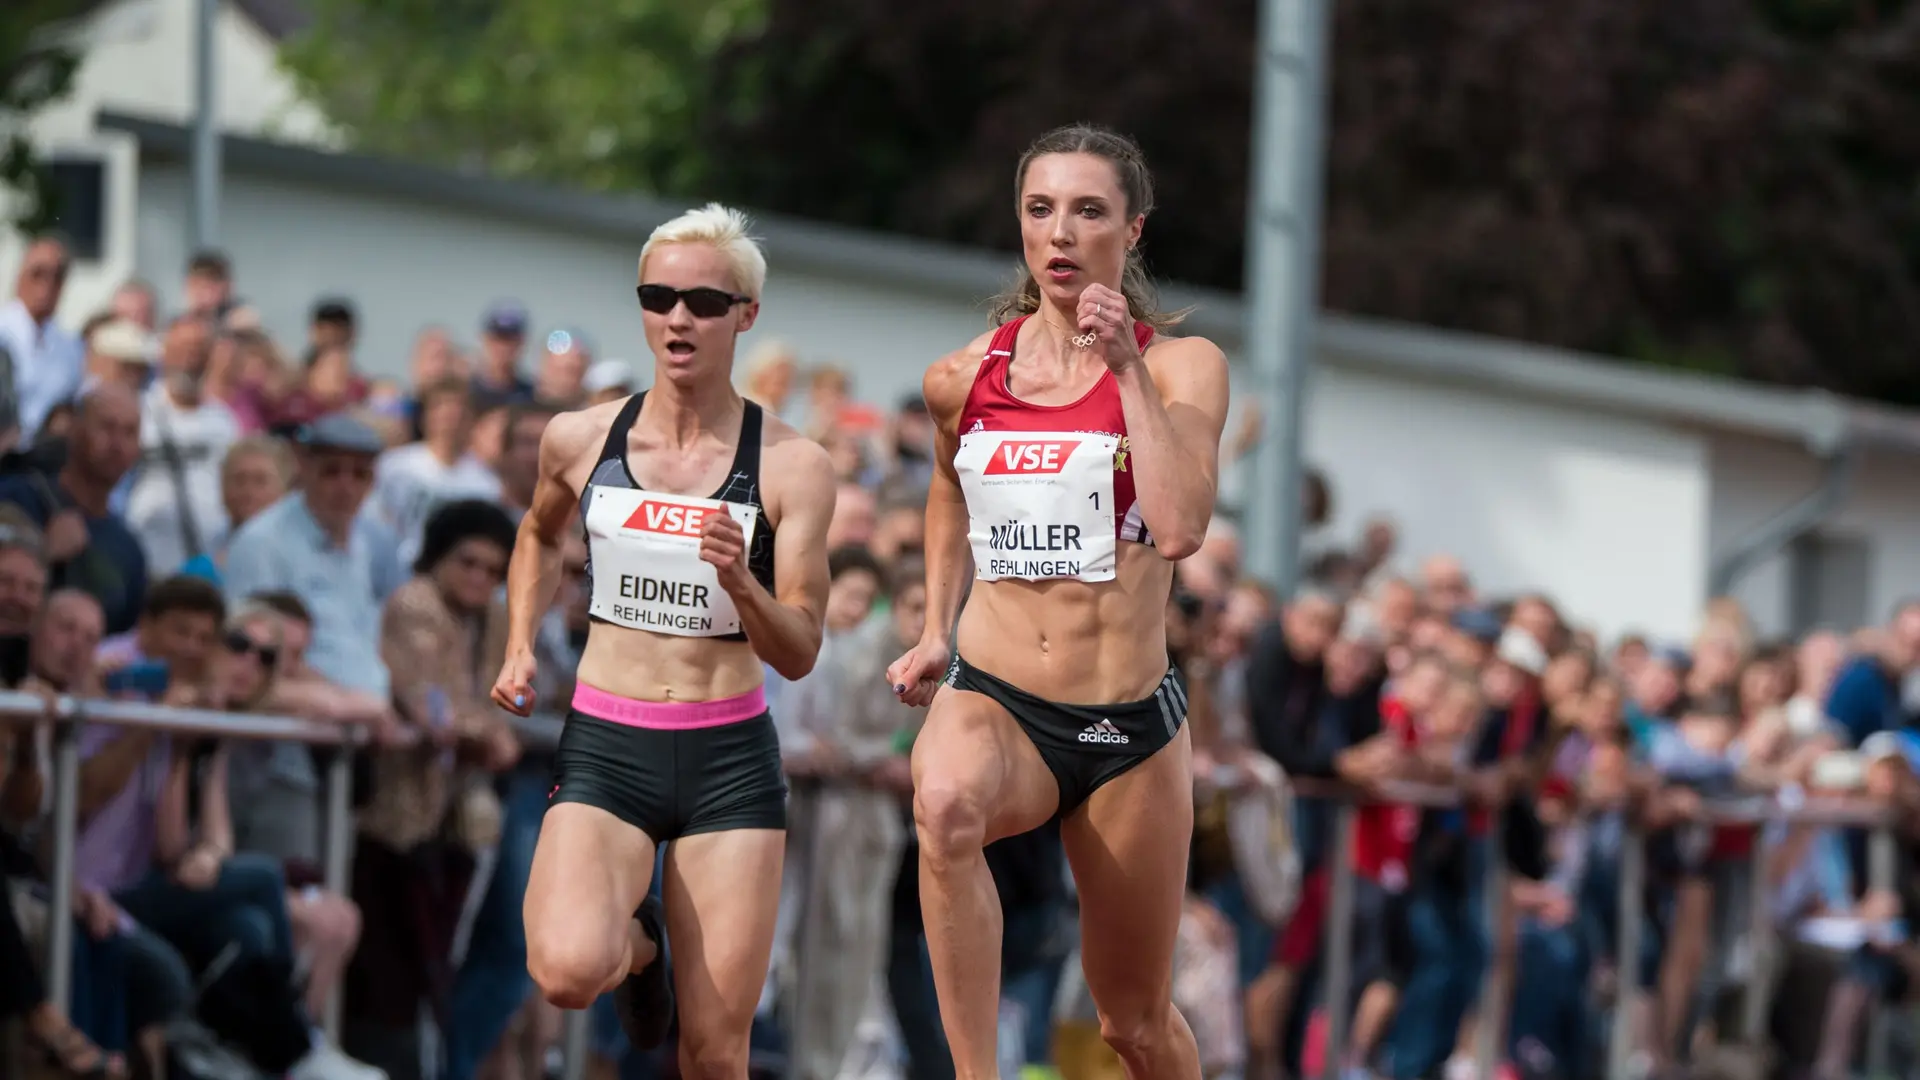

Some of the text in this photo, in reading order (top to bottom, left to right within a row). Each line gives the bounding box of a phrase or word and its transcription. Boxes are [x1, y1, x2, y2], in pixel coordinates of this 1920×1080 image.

[1003, 444, 1060, 470] VSE
[1088, 492, 1099, 510] 1
[645, 504, 703, 534] VSE
[989, 520, 1081, 550] MÜLLER
[990, 559, 1080, 576] REHLINGEN
[620, 574, 709, 608] EIDNER
[613, 604, 712, 630] REHLINGEN
[1078, 732, 1129, 744] adidas
